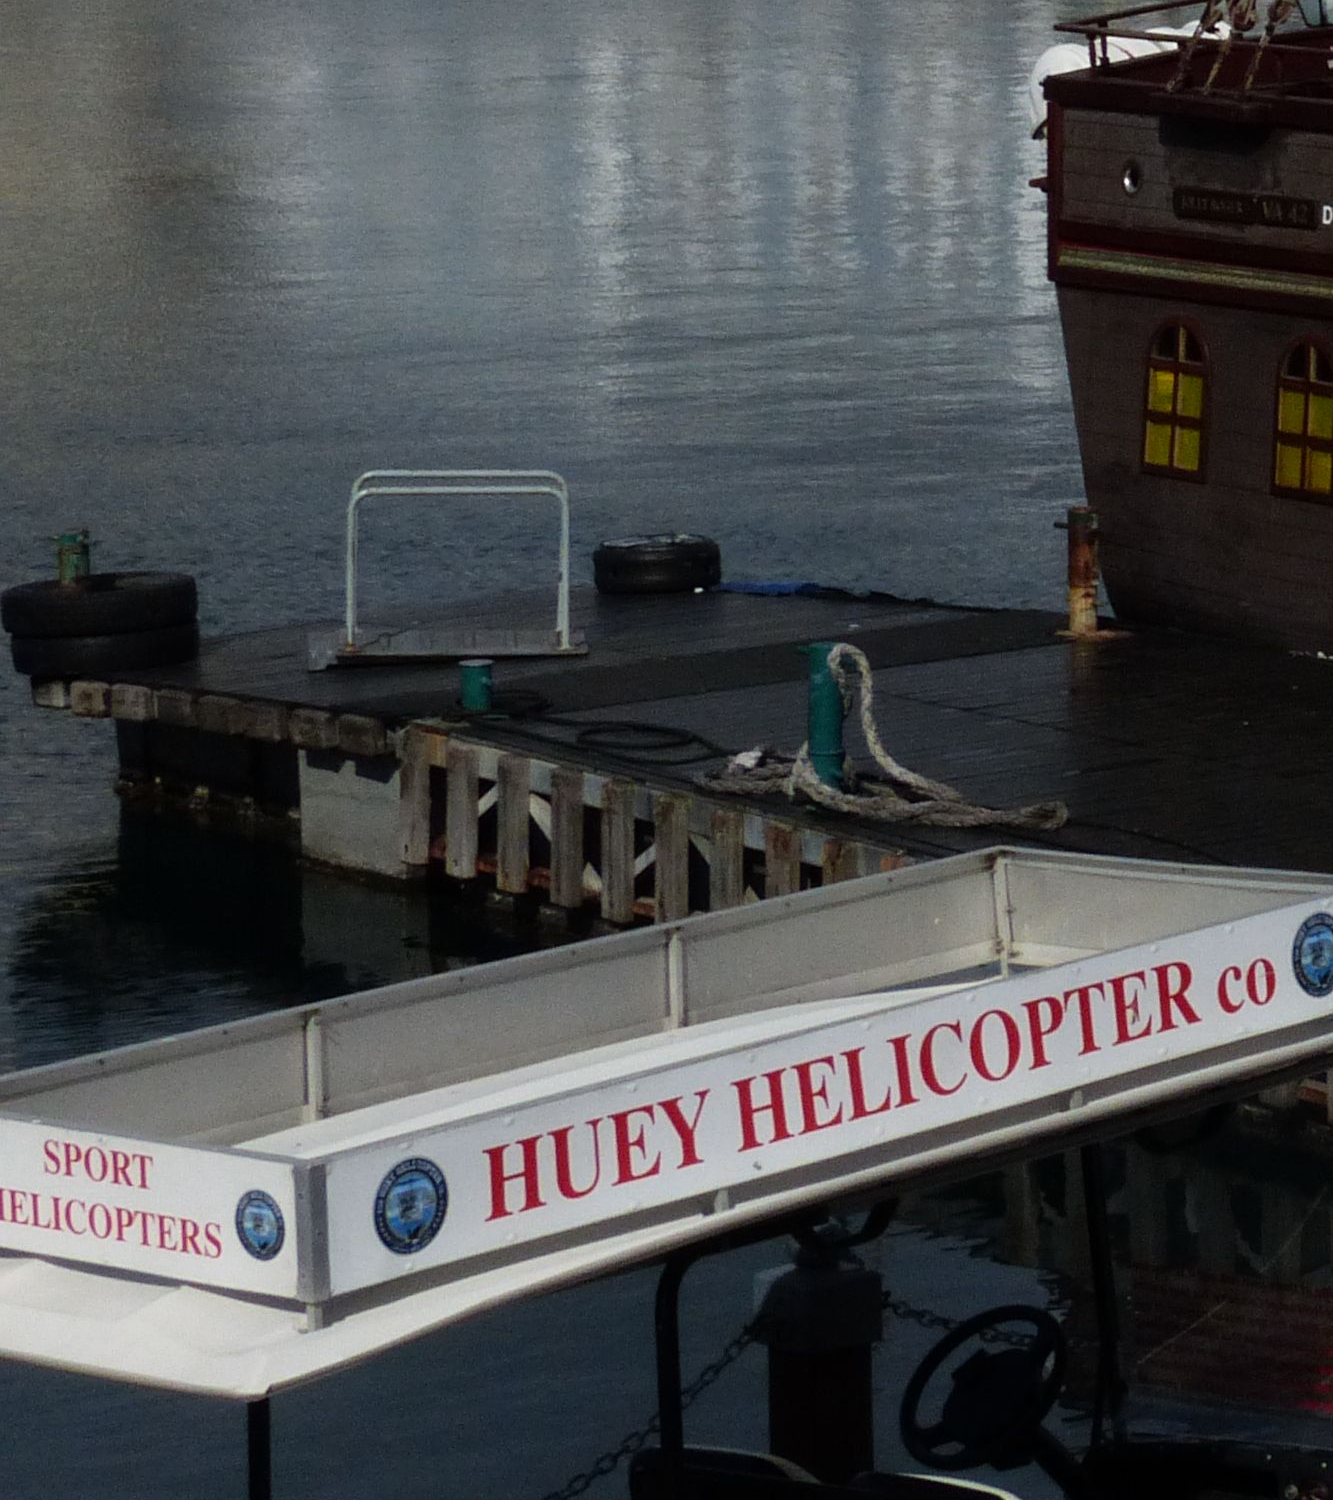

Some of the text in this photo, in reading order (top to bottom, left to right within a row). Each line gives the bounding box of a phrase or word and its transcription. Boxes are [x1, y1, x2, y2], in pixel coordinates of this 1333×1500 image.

[43, 1139, 154, 1190] SPORT
[482, 1088, 710, 1222] HUEY
[730, 960, 1202, 1153] HELICOPTER
